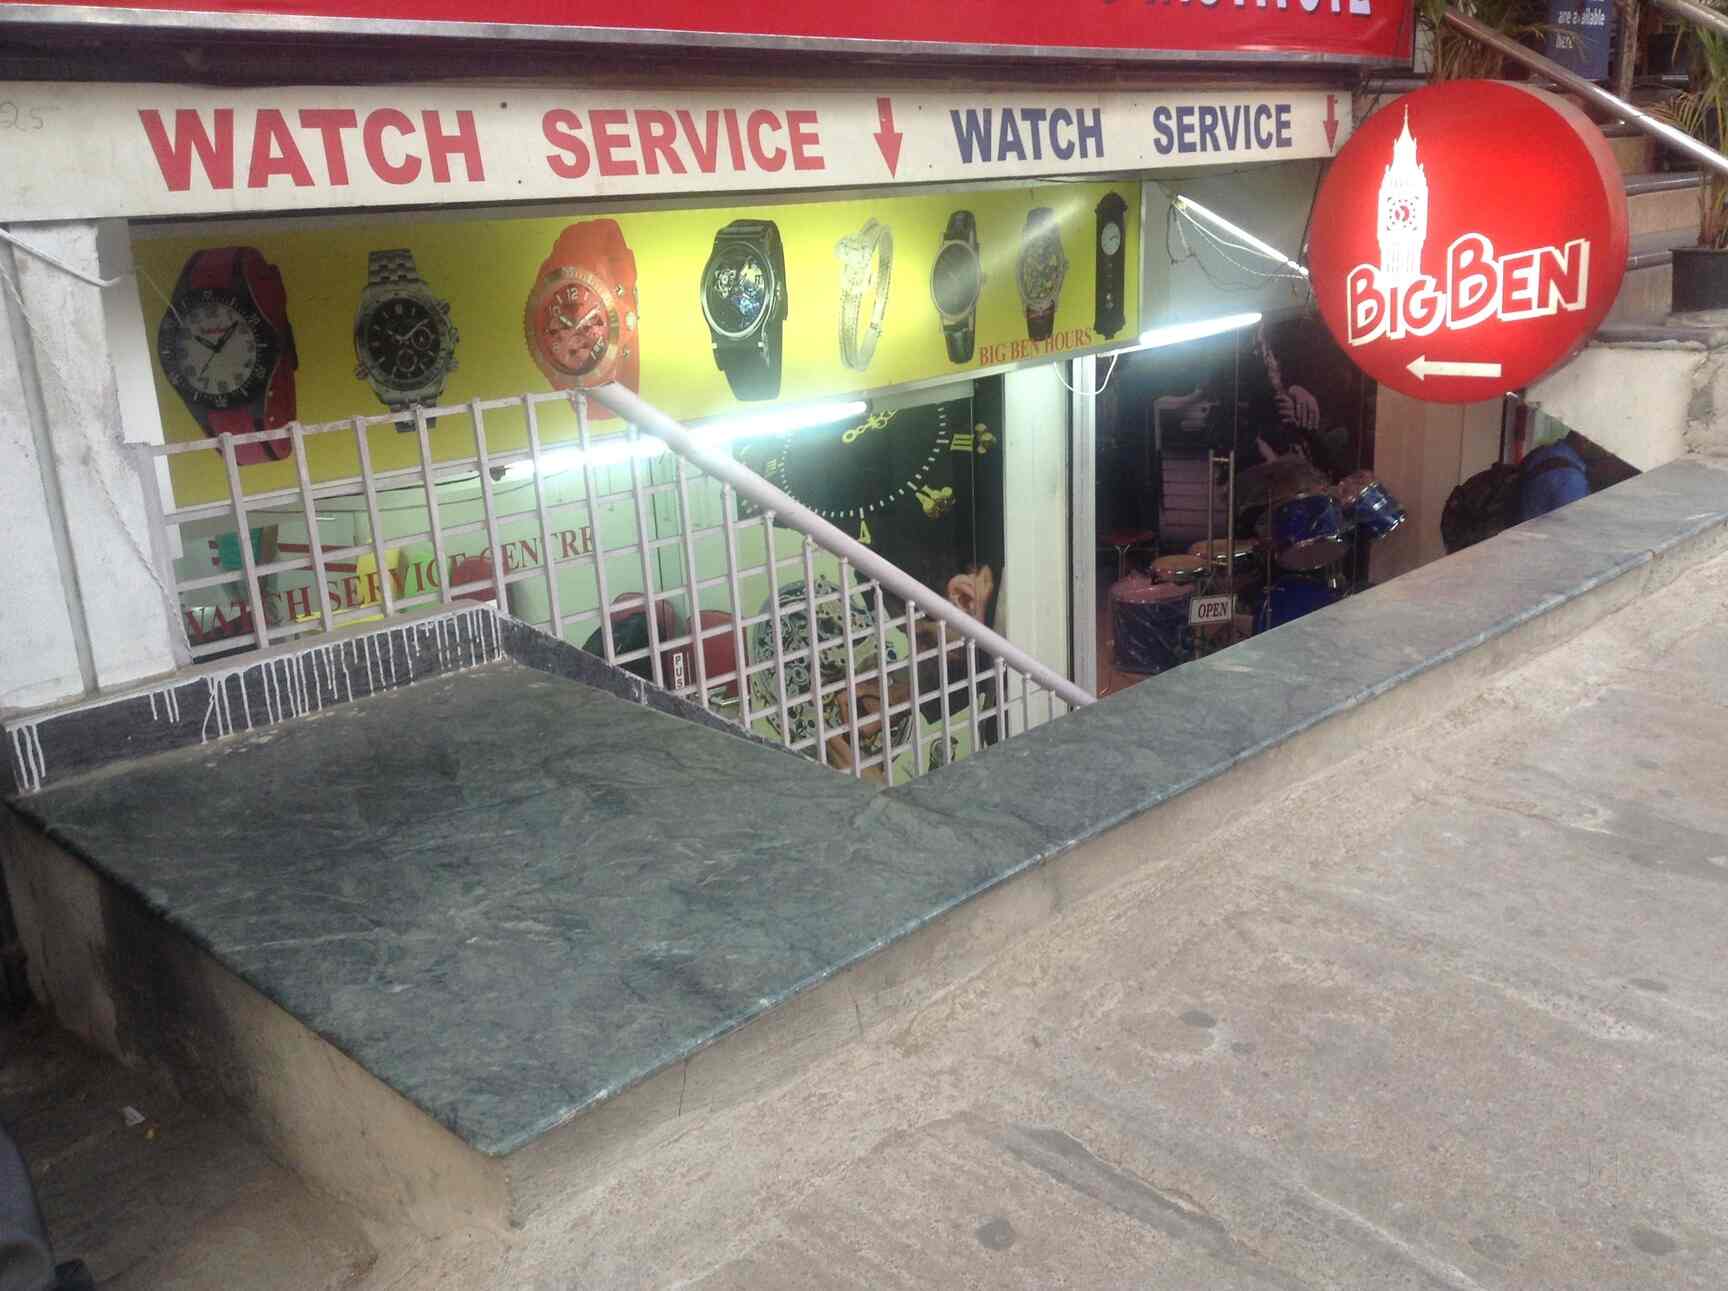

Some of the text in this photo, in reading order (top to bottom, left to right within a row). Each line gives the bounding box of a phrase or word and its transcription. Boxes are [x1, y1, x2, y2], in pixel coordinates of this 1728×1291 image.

[139, 103, 1292, 191] WATCH SERVICE WATCH SERVICE
[1346, 232, 1590, 346] BIG BEN
[979, 328, 1093, 365] BIG BEN HOURS
[479, 525, 593, 582] CENRE
[1199, 602, 1228, 617] OPEN
[675, 655, 683, 689] PUS
